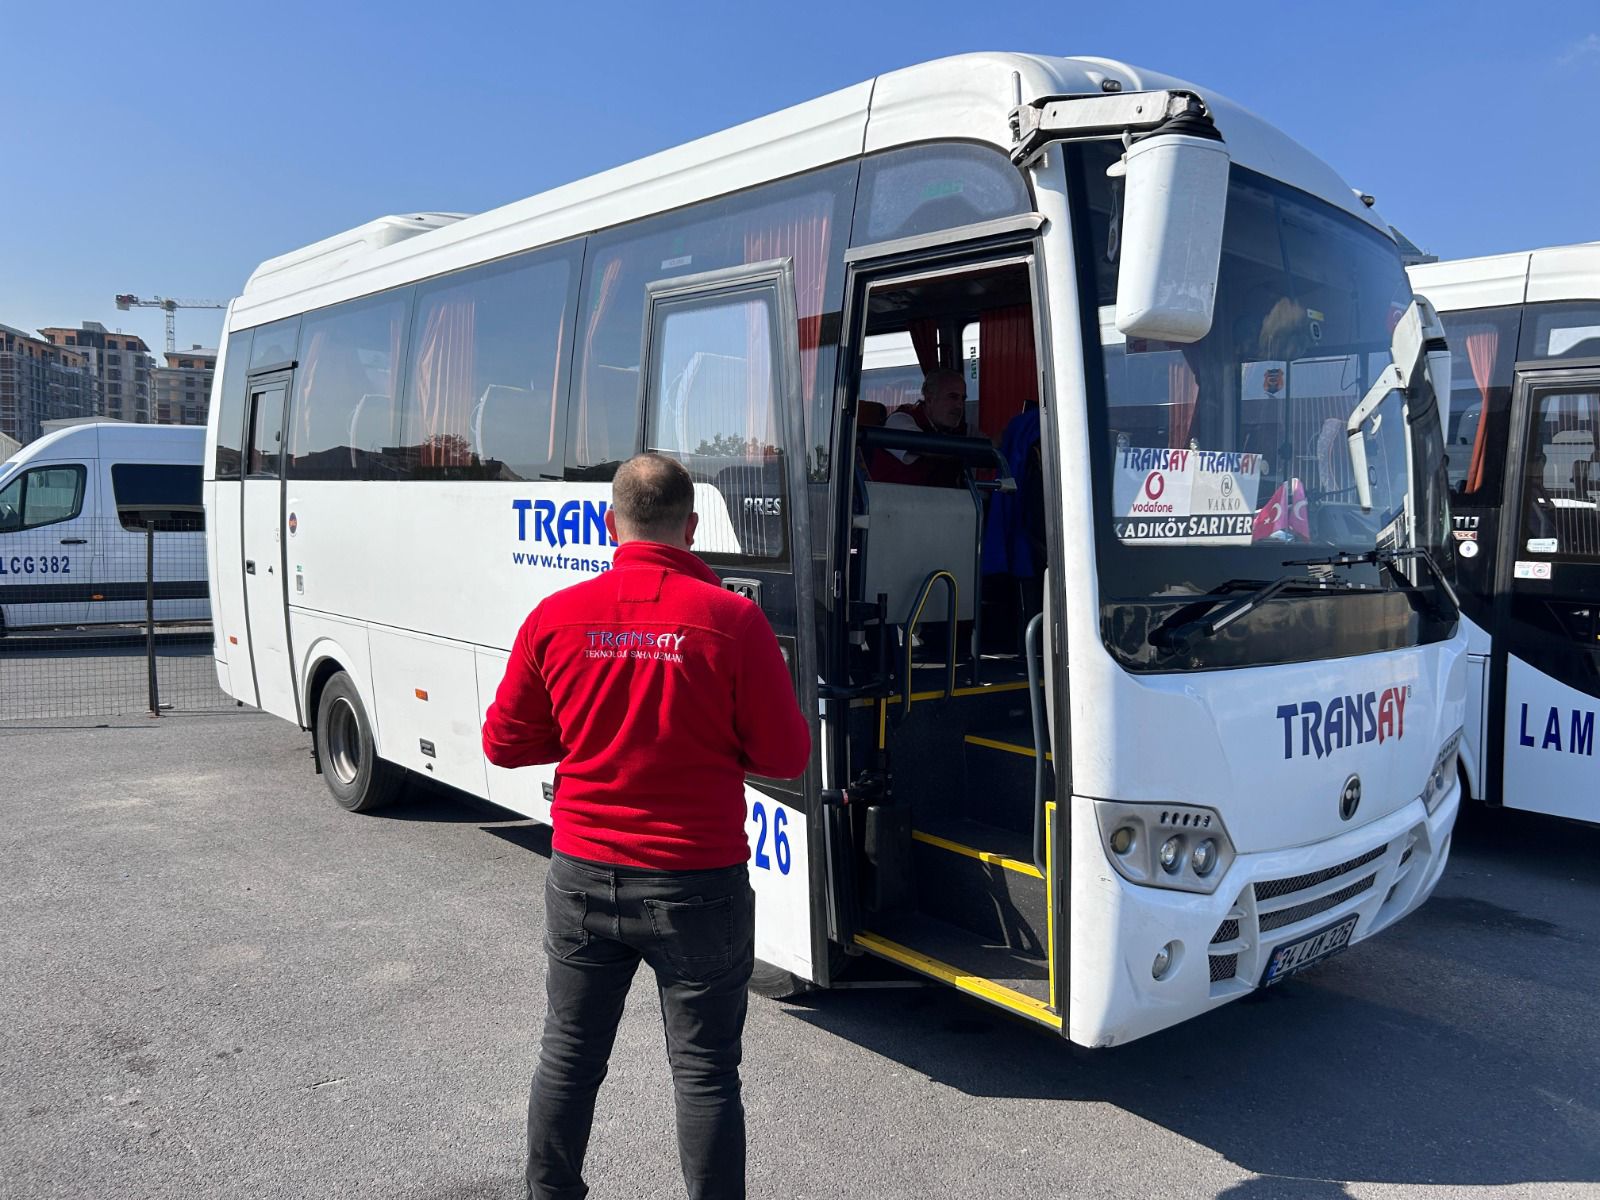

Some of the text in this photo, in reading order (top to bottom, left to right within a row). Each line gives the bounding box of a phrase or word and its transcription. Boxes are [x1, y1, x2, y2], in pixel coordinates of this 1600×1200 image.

[1122, 449, 1189, 472] TRANSAY
[1199, 452, 1257, 474] TRANSAY
[744, 497, 781, 516] PRES
[1132, 502, 1173, 513] vodafone
[1208, 498, 1241, 511] VAKKO
[512, 499, 618, 548] TRAN
[1189, 516, 1252, 536] SARIYER
[1453, 516, 1480, 528] TIJ
[39, 555, 70, 573] 382
[512, 552, 615, 573] www.transa
[586, 631, 686, 650] TRANSAY
[630, 651, 651, 660] SAHA
[1519, 702, 1595, 756] LAM
[752, 801, 791, 876] 26
[1275, 946, 1298, 973] 34
